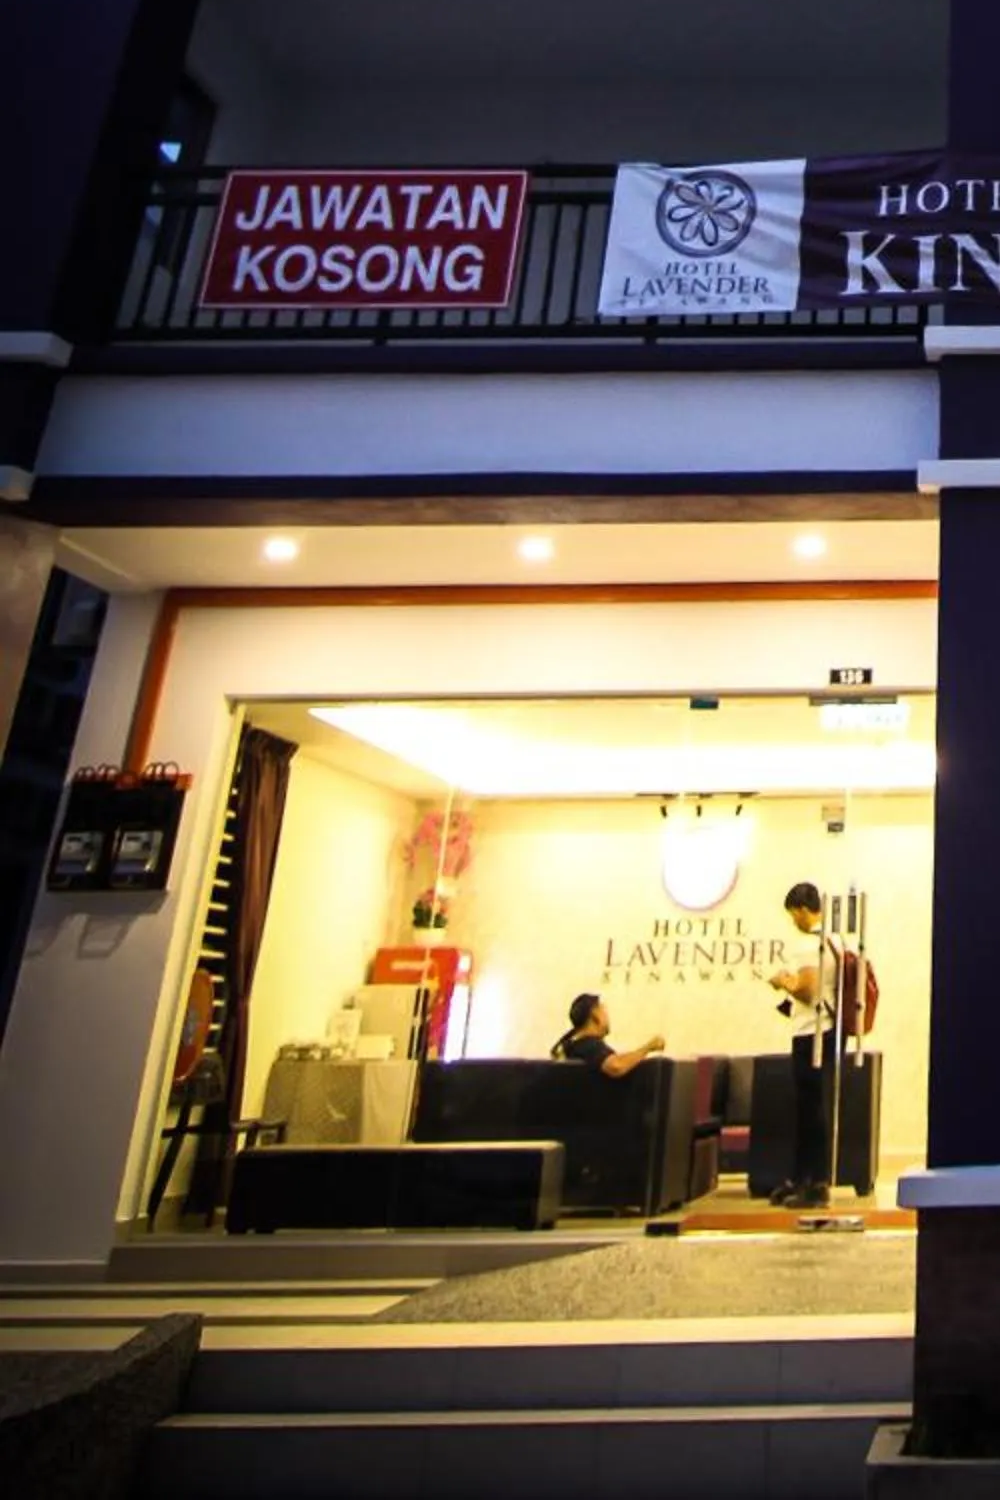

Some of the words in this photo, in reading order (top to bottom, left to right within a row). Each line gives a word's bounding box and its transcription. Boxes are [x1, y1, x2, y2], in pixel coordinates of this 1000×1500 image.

[234, 184, 510, 232] JAWATAN
[231, 243, 486, 294] KOSONG
[664, 261, 739, 277] HOTEL
[622, 275, 770, 298] LAVENDER
[653, 918, 748, 938] HOTEL
[605, 938, 788, 967] LAVENDER
[601, 968, 764, 984] SENAWAN
